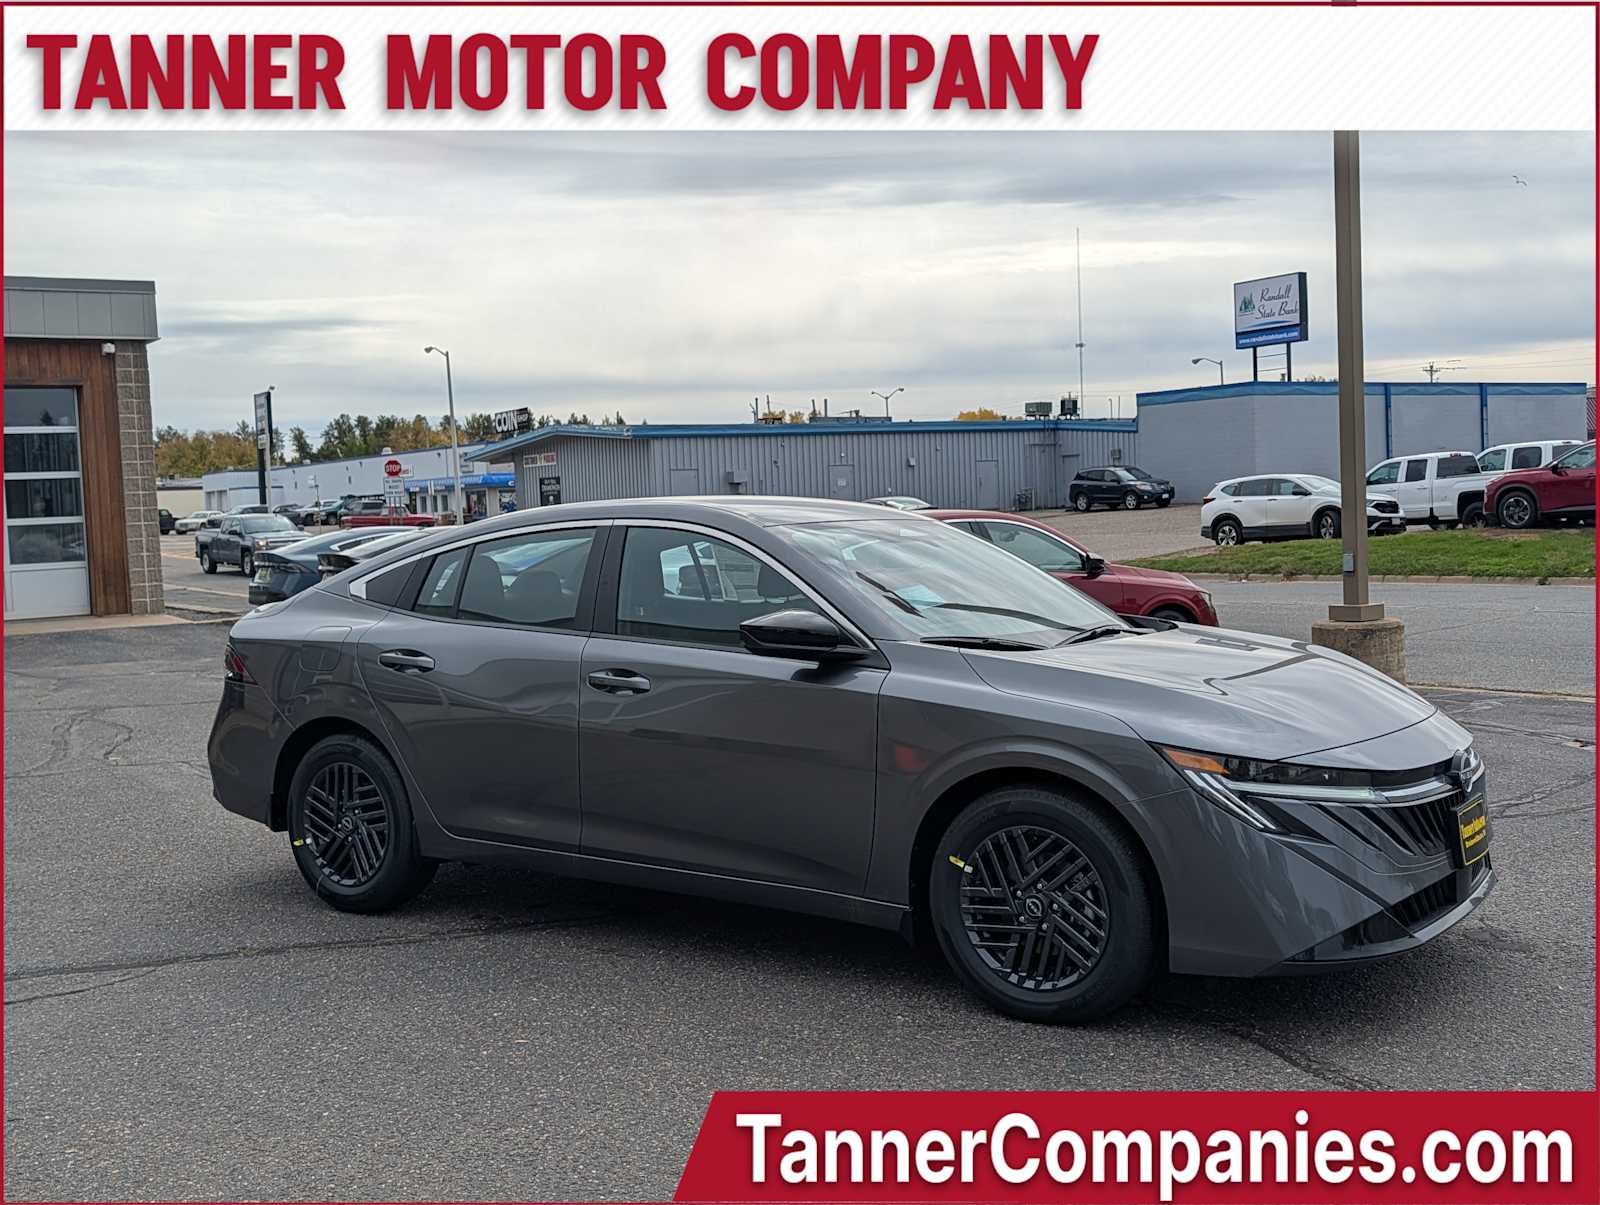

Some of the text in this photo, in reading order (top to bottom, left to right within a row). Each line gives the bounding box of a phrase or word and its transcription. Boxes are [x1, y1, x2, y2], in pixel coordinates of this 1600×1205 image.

[1260, 284, 1292, 303] Randall
[1256, 301, 1299, 319] State Bank
[495, 411, 519, 433] COIN
[385, 464, 401, 473] STOP
